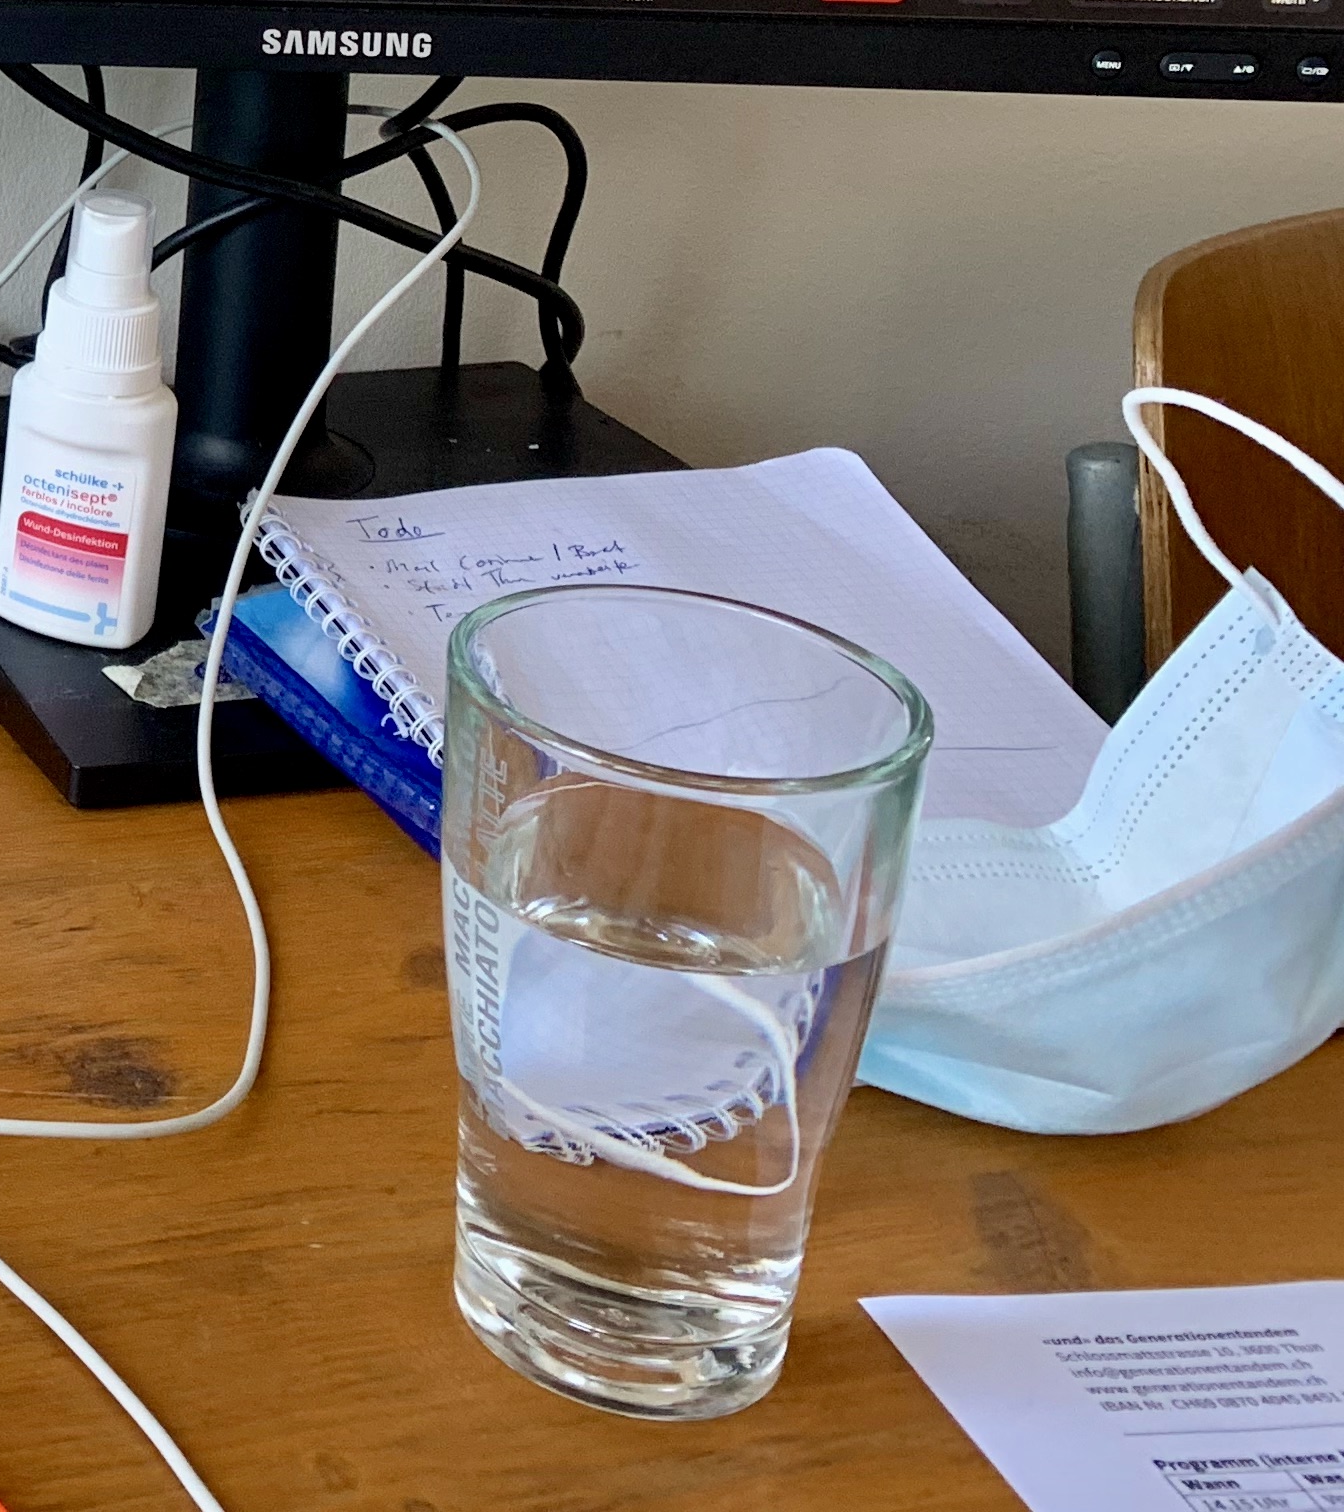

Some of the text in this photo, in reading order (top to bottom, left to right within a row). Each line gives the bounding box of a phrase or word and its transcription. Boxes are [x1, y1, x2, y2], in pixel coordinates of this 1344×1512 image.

[261, 28, 433, 59] SAMSUNG
[1095, 60, 1122, 70] MENU
[55, 468, 108, 489] schülke
[22, 486, 113, 518] farblos incolore
[23, 517, 119, 550] Wund-Desinfektion
[1126, 1328, 1299, 1344] Generationentandem
[1153, 1457, 1259, 1473] Programm
[1181, 1479, 1240, 1490] Wann
